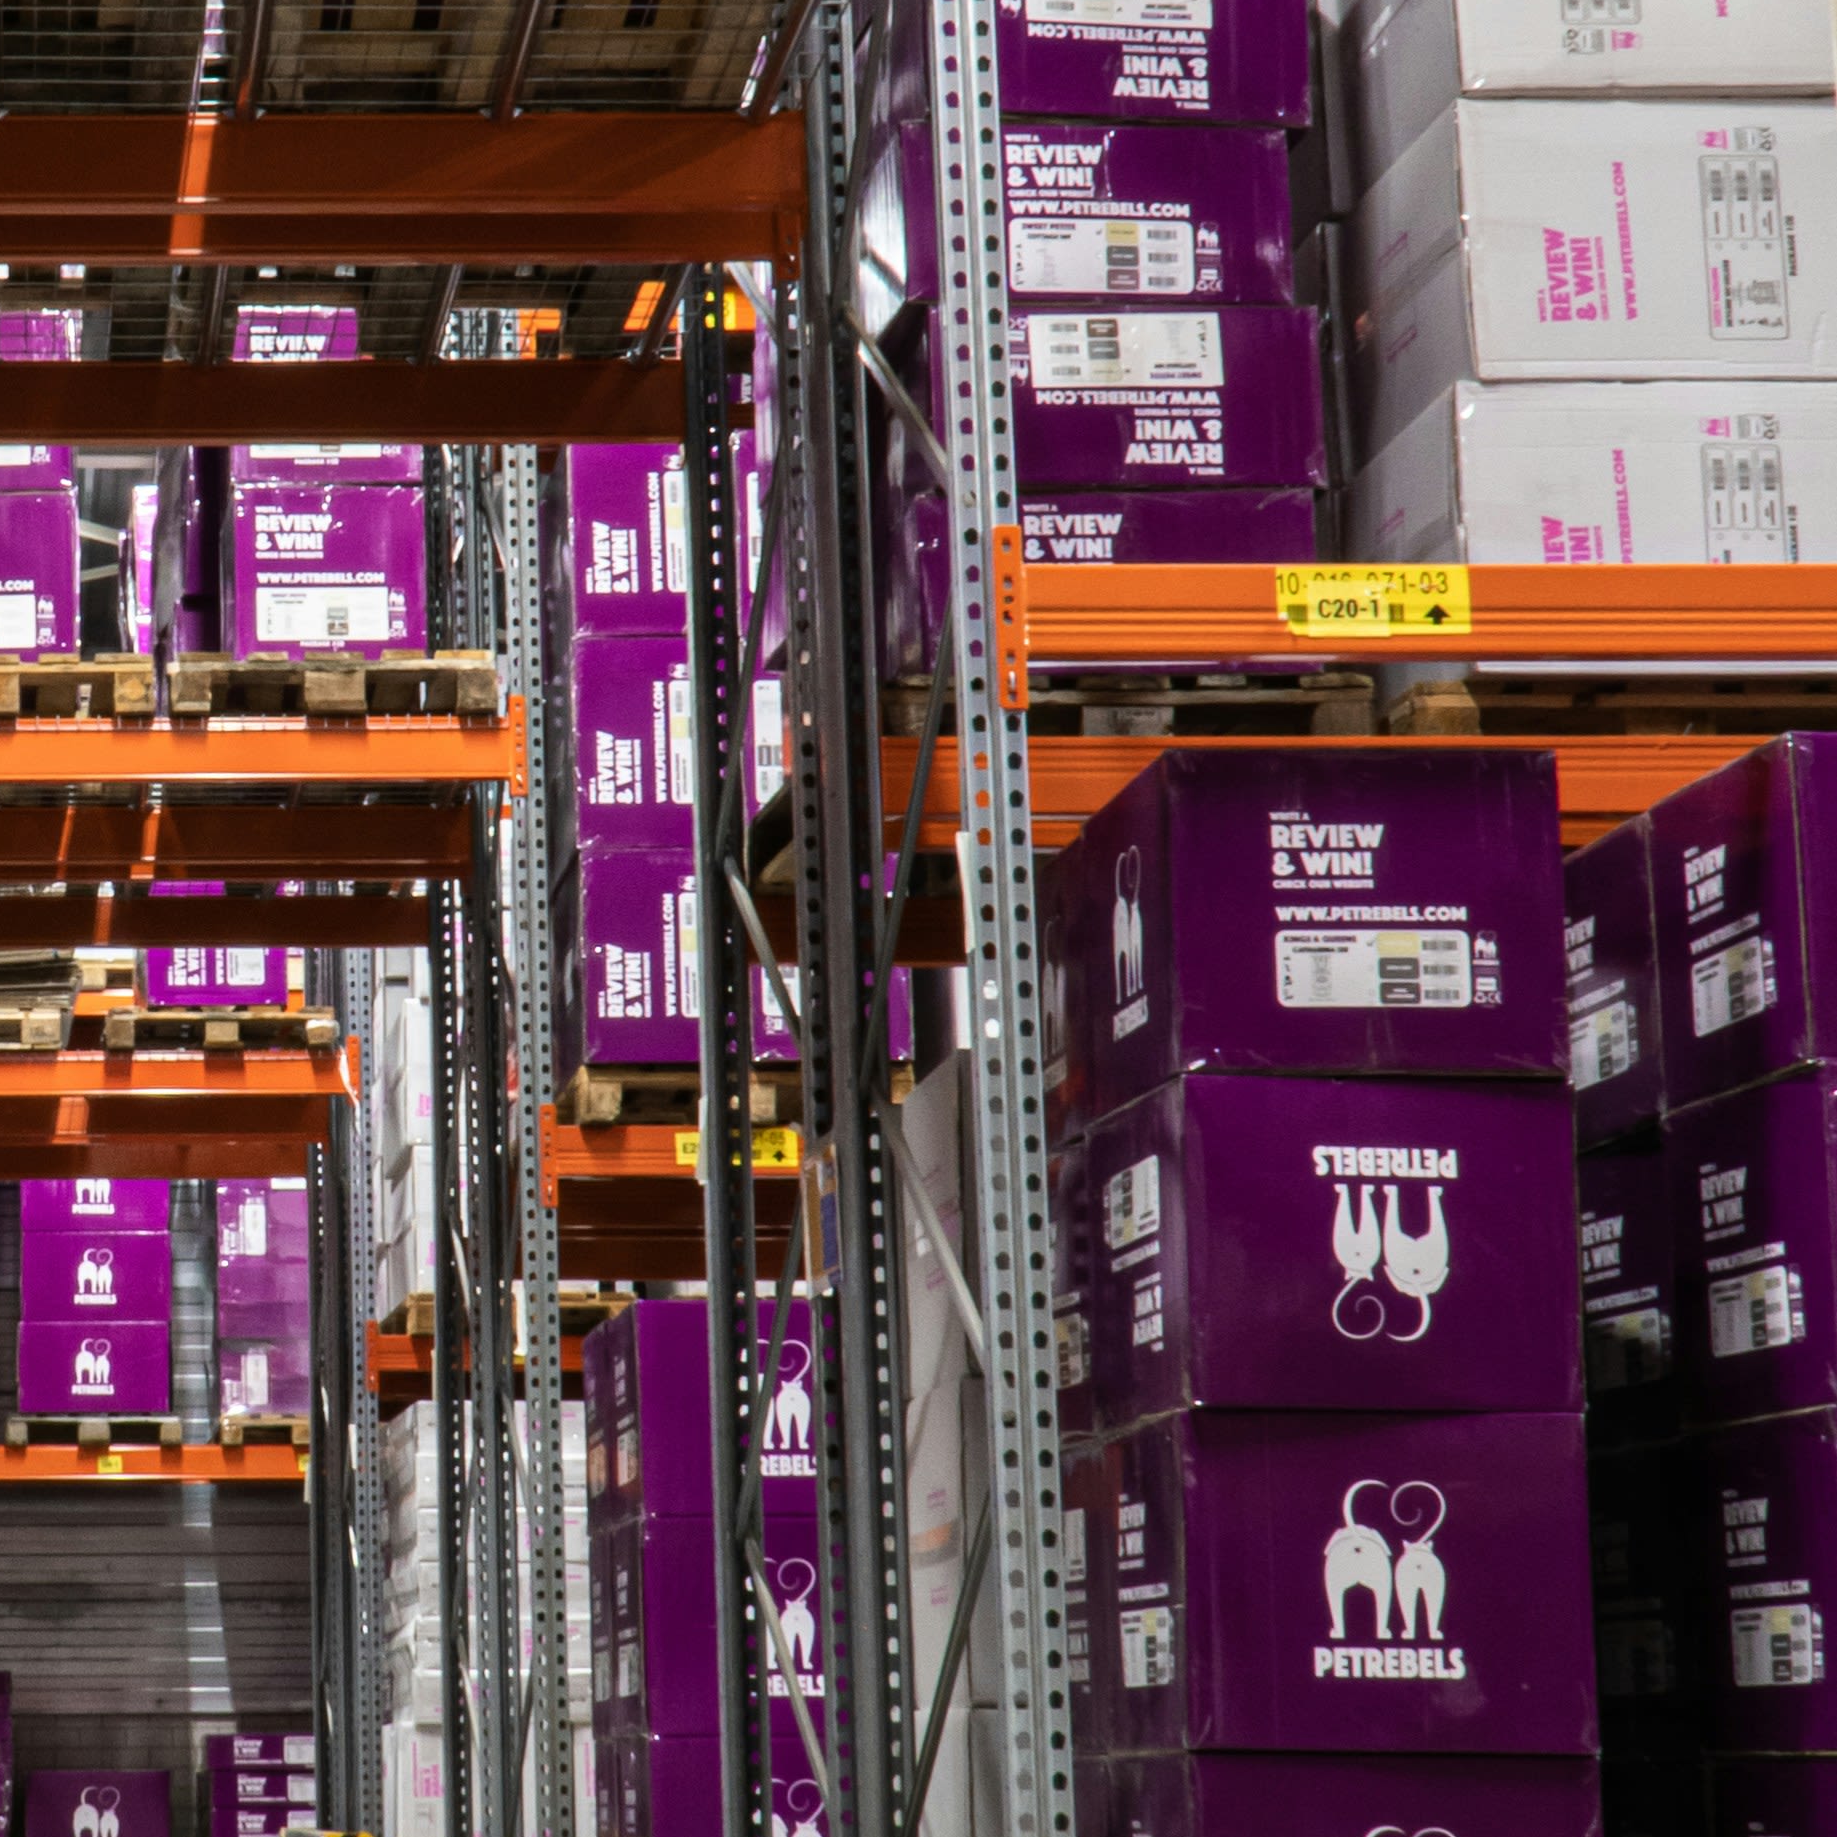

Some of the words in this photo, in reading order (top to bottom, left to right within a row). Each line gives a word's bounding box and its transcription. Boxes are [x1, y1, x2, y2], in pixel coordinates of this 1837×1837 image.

[1027, 23, 1206, 44] WWW.PETREBELS.COM
[1123, 54, 1184, 76] WIN!
[1187, 57, 1208, 77] &
[1113, 77, 1210, 100] REVIEW
[1005, 144, 1102, 166] REVIEW
[1006, 167, 1029, 188] &
[1031, 166, 1094, 188] WIN!
[1009, 199, 1191, 219] WWW.PETREBELS.COM
[1611, 161, 1640, 320] WWW.PETREBELS.COM
[1542, 227, 1572, 322] REVIEW
[1570, 236, 1596, 297] WIN!
[1575, 302, 1597, 321] &
[1035, 390, 1220, 406] WWW.PETREBELS.COM
[1134, 419, 1198, 440] WIN!
[1205, 419, 1222, 440] &
[1124, 442, 1224, 464] REVIEW
[255, 514, 333, 534] REVIEW
[1022, 513, 1123, 536] REVIEW
[255, 533, 274, 551] &
[277, 532, 325, 551] WIN!
[610, 529, 630, 576] WIN!
[1024, 537, 1046, 559] &
[1049, 537, 1112, 559] WIN!
[592, 520, 612, 594] REVIEW
[1318, 599, 1380, 619] C20-1
[596, 730, 616, 804] REVIEW
[614, 739, 633, 786] WIN!
[1270, 824, 1384, 849] REVIEW
[1271, 851, 1296, 876] &
[1300, 851, 1373, 876] WIN!
[1274, 906, 1468, 922] WWW.PETREBELS.COM
[605, 943, 625, 1018] REVIEW
[623, 952, 643, 1000] WIN!
[1312, 1145, 1459, 1181] PETREBELS
[1313, 1646, 1467, 1680] PETREBELS
